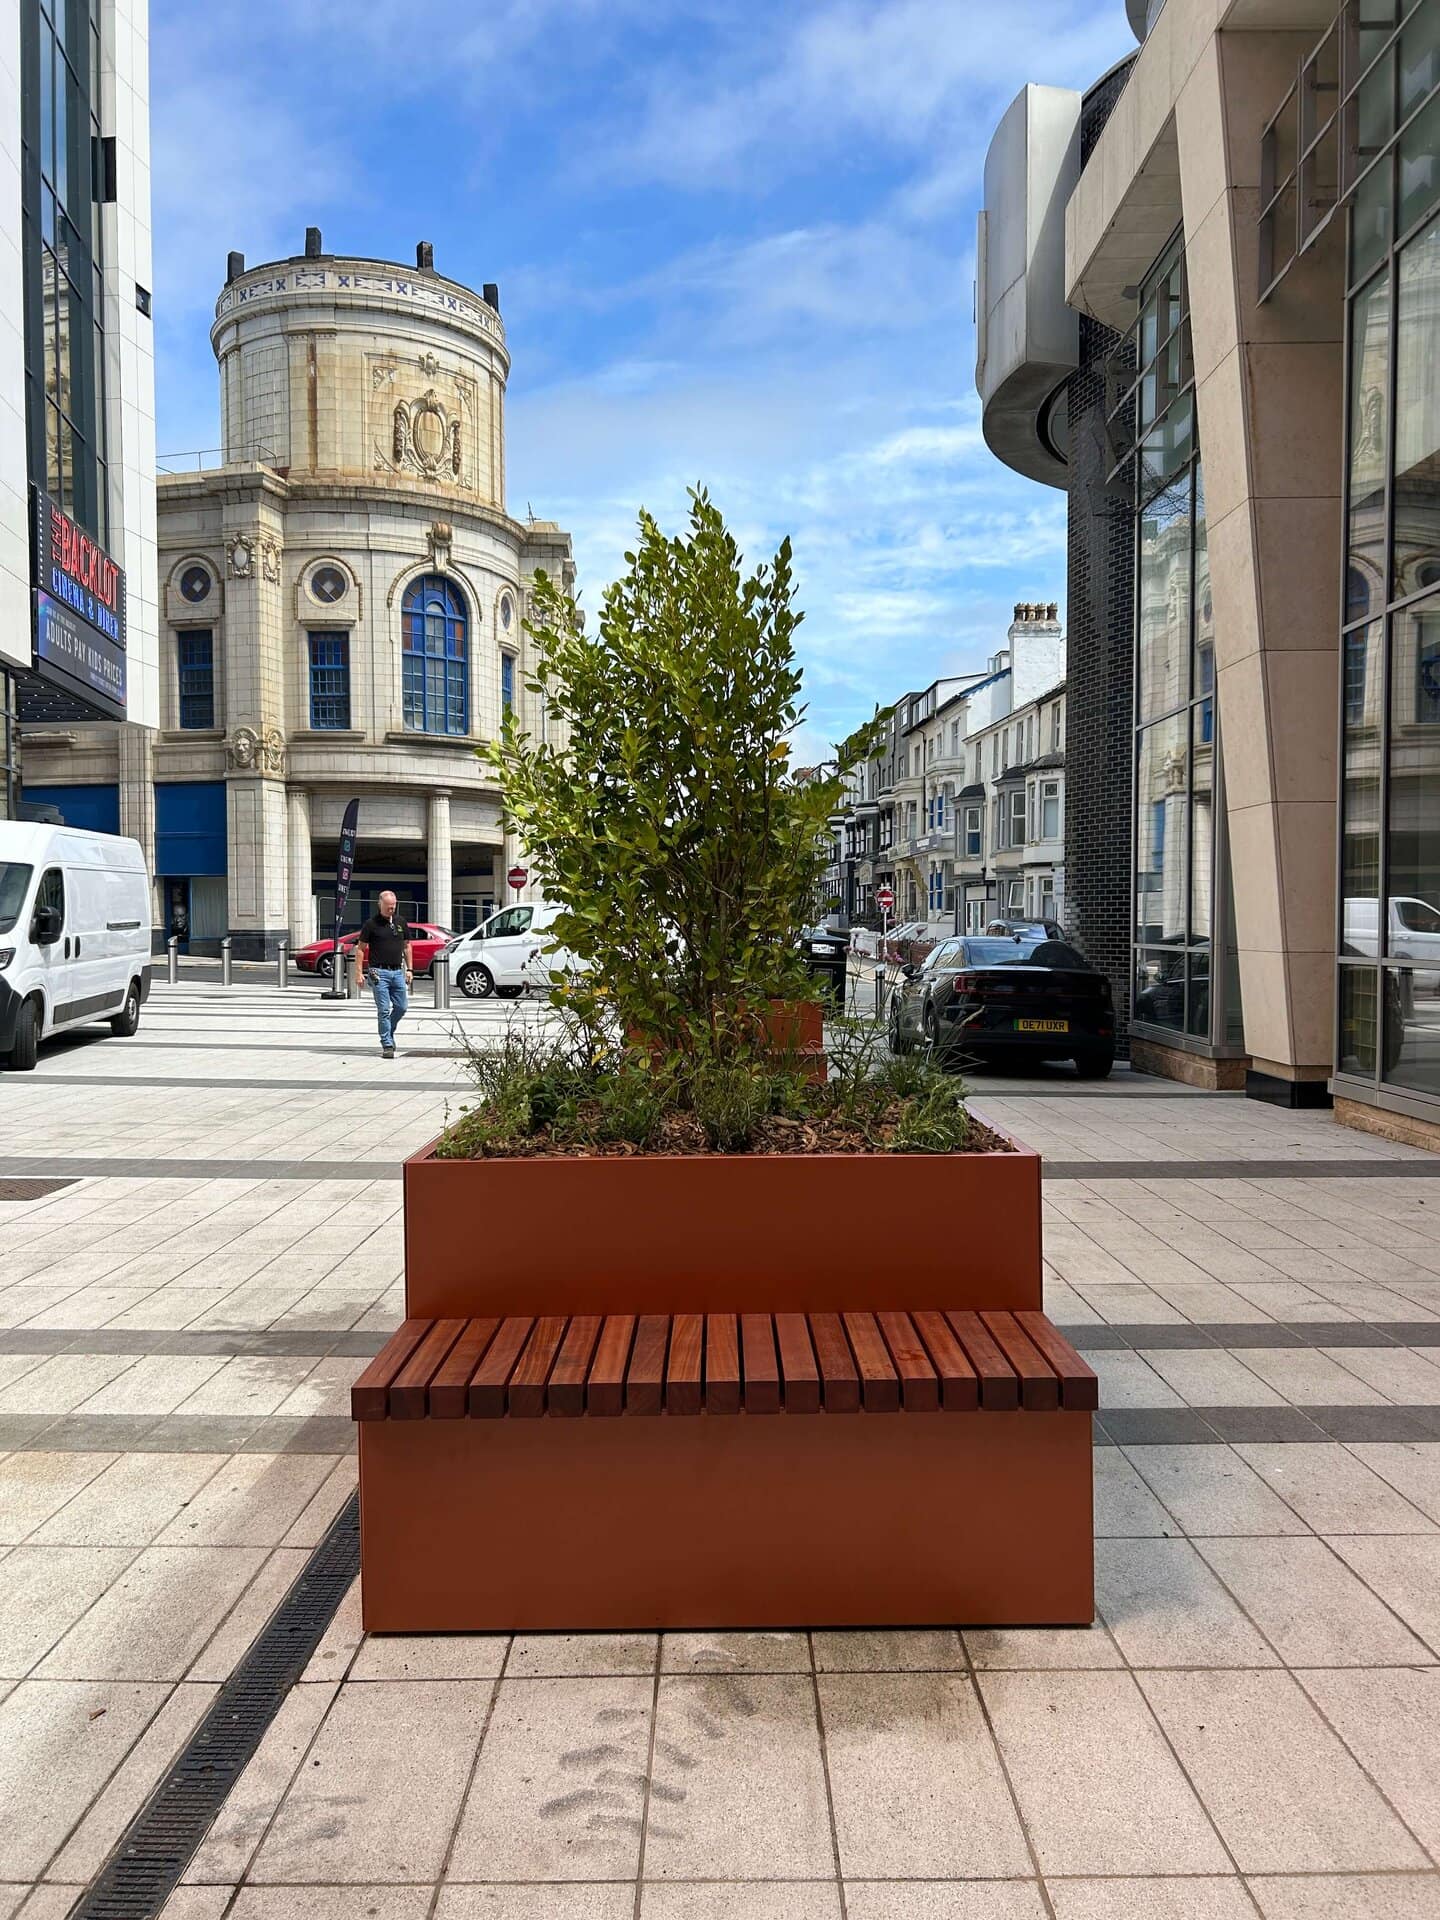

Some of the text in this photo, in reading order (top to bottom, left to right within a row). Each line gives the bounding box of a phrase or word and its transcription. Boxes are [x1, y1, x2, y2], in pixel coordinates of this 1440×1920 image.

[51, 505, 62, 561] THE
[61, 515, 119, 612] BACKLOT
[52, 567, 85, 613] CINEMA
[88, 597, 94, 619] &
[97, 603, 119, 641] DINER
[46, 618, 72, 654] ADULTS
[74, 637, 86, 663] PAY
[87, 646, 102, 673] KIDS
[103, 657, 122, 686] PRICES
[1046, 1021, 1065, 1030] UXR
